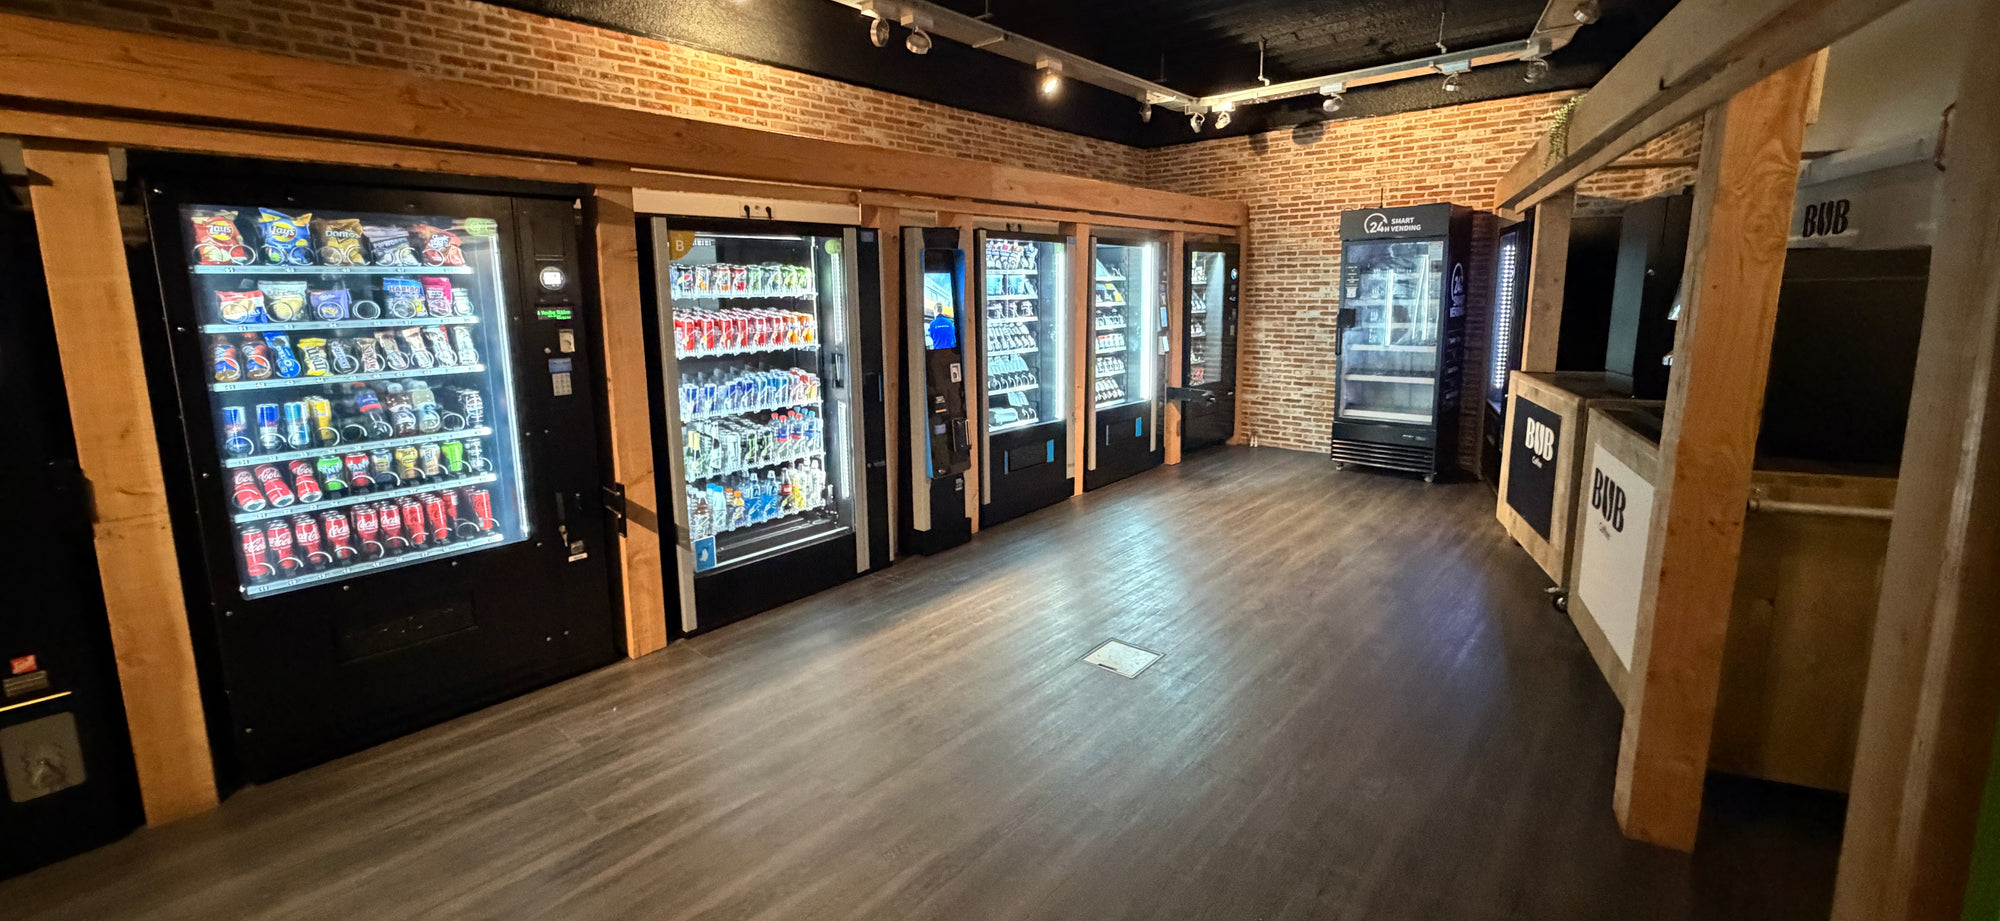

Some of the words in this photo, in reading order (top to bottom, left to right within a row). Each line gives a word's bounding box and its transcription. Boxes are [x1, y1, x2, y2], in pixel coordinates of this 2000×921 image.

[1391, 224, 1422, 232] VENDING
[325, 230, 361, 239] Doritos
[675, 239, 685, 252] B
